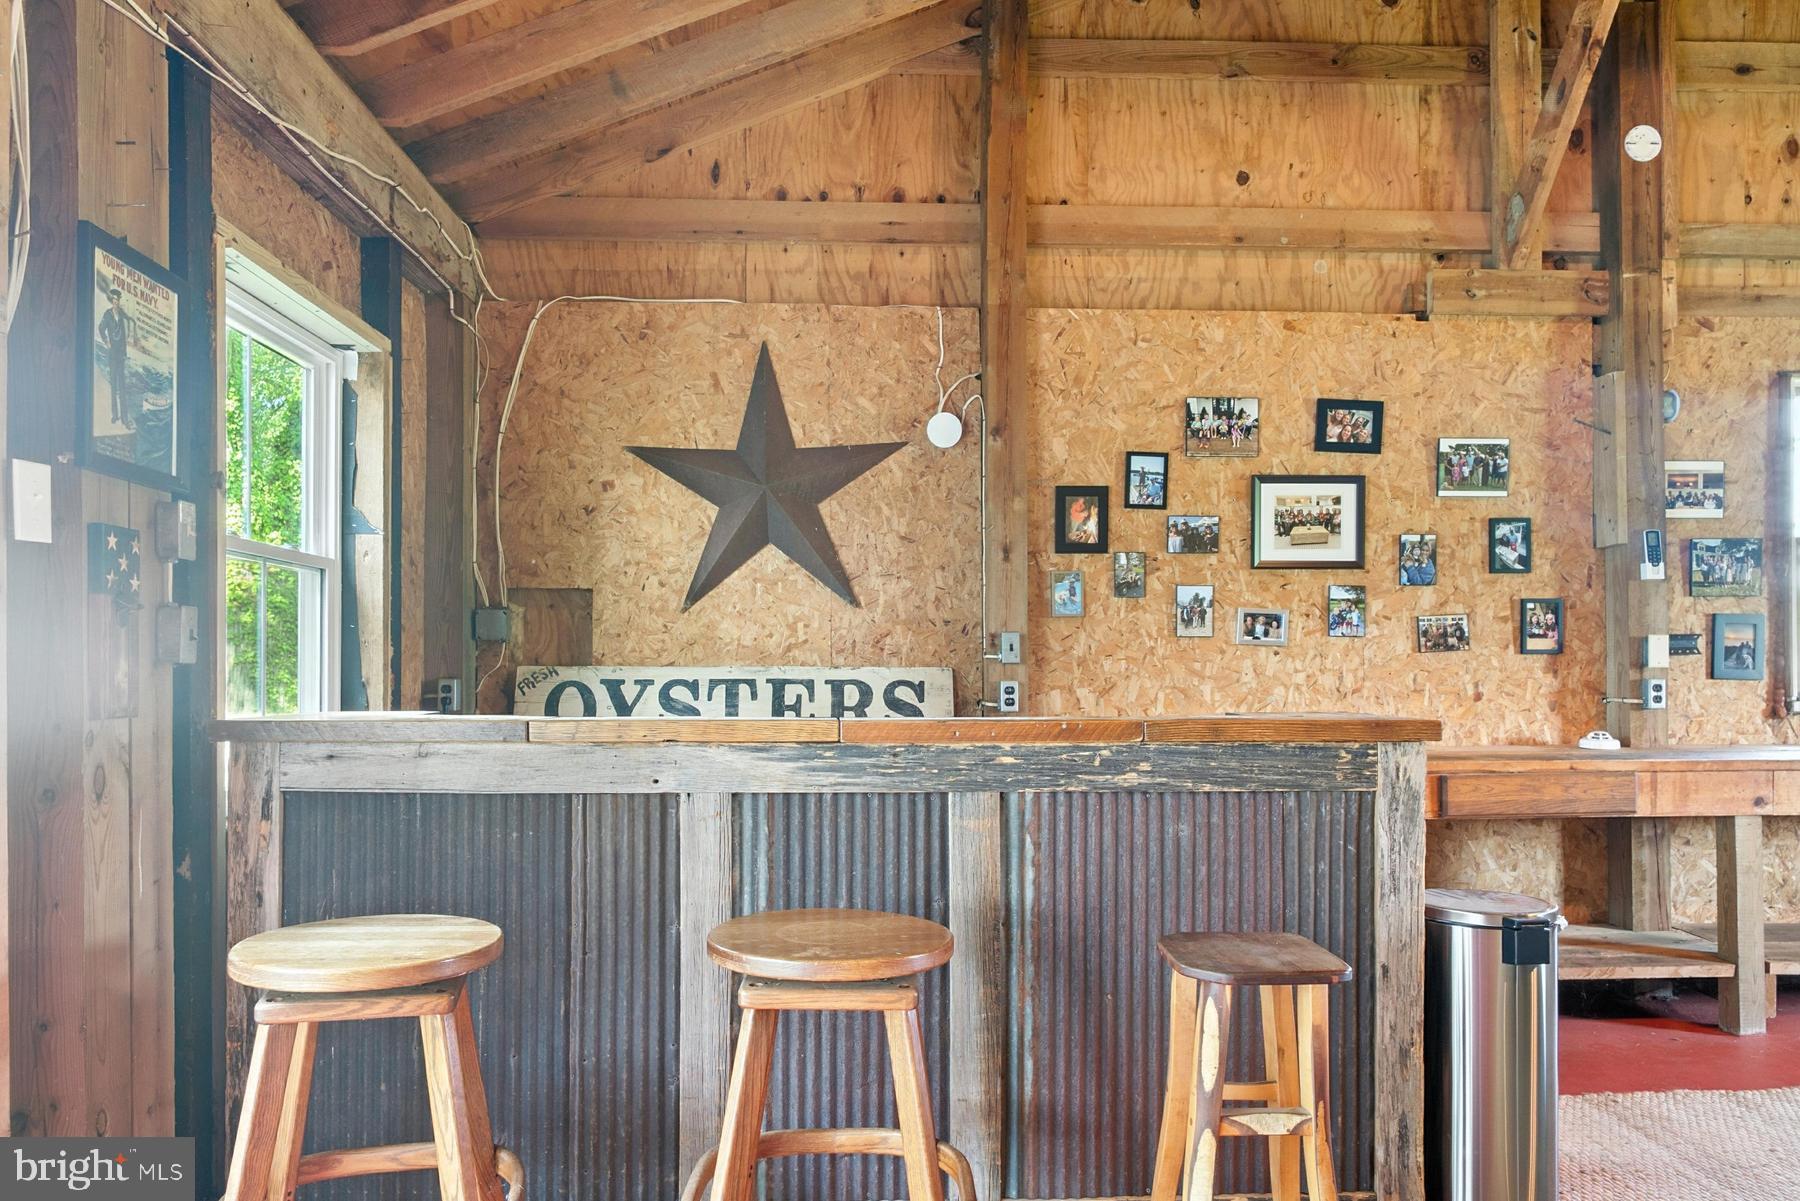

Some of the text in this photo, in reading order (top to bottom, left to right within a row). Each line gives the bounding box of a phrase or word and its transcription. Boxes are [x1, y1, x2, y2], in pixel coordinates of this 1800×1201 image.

[101, 252, 170, 301] YOUNG MEN WANTED
[112, 274, 125, 291] FOR
[516, 666, 560, 696] FRESH
[544, 678, 925, 717] OYSTERS
